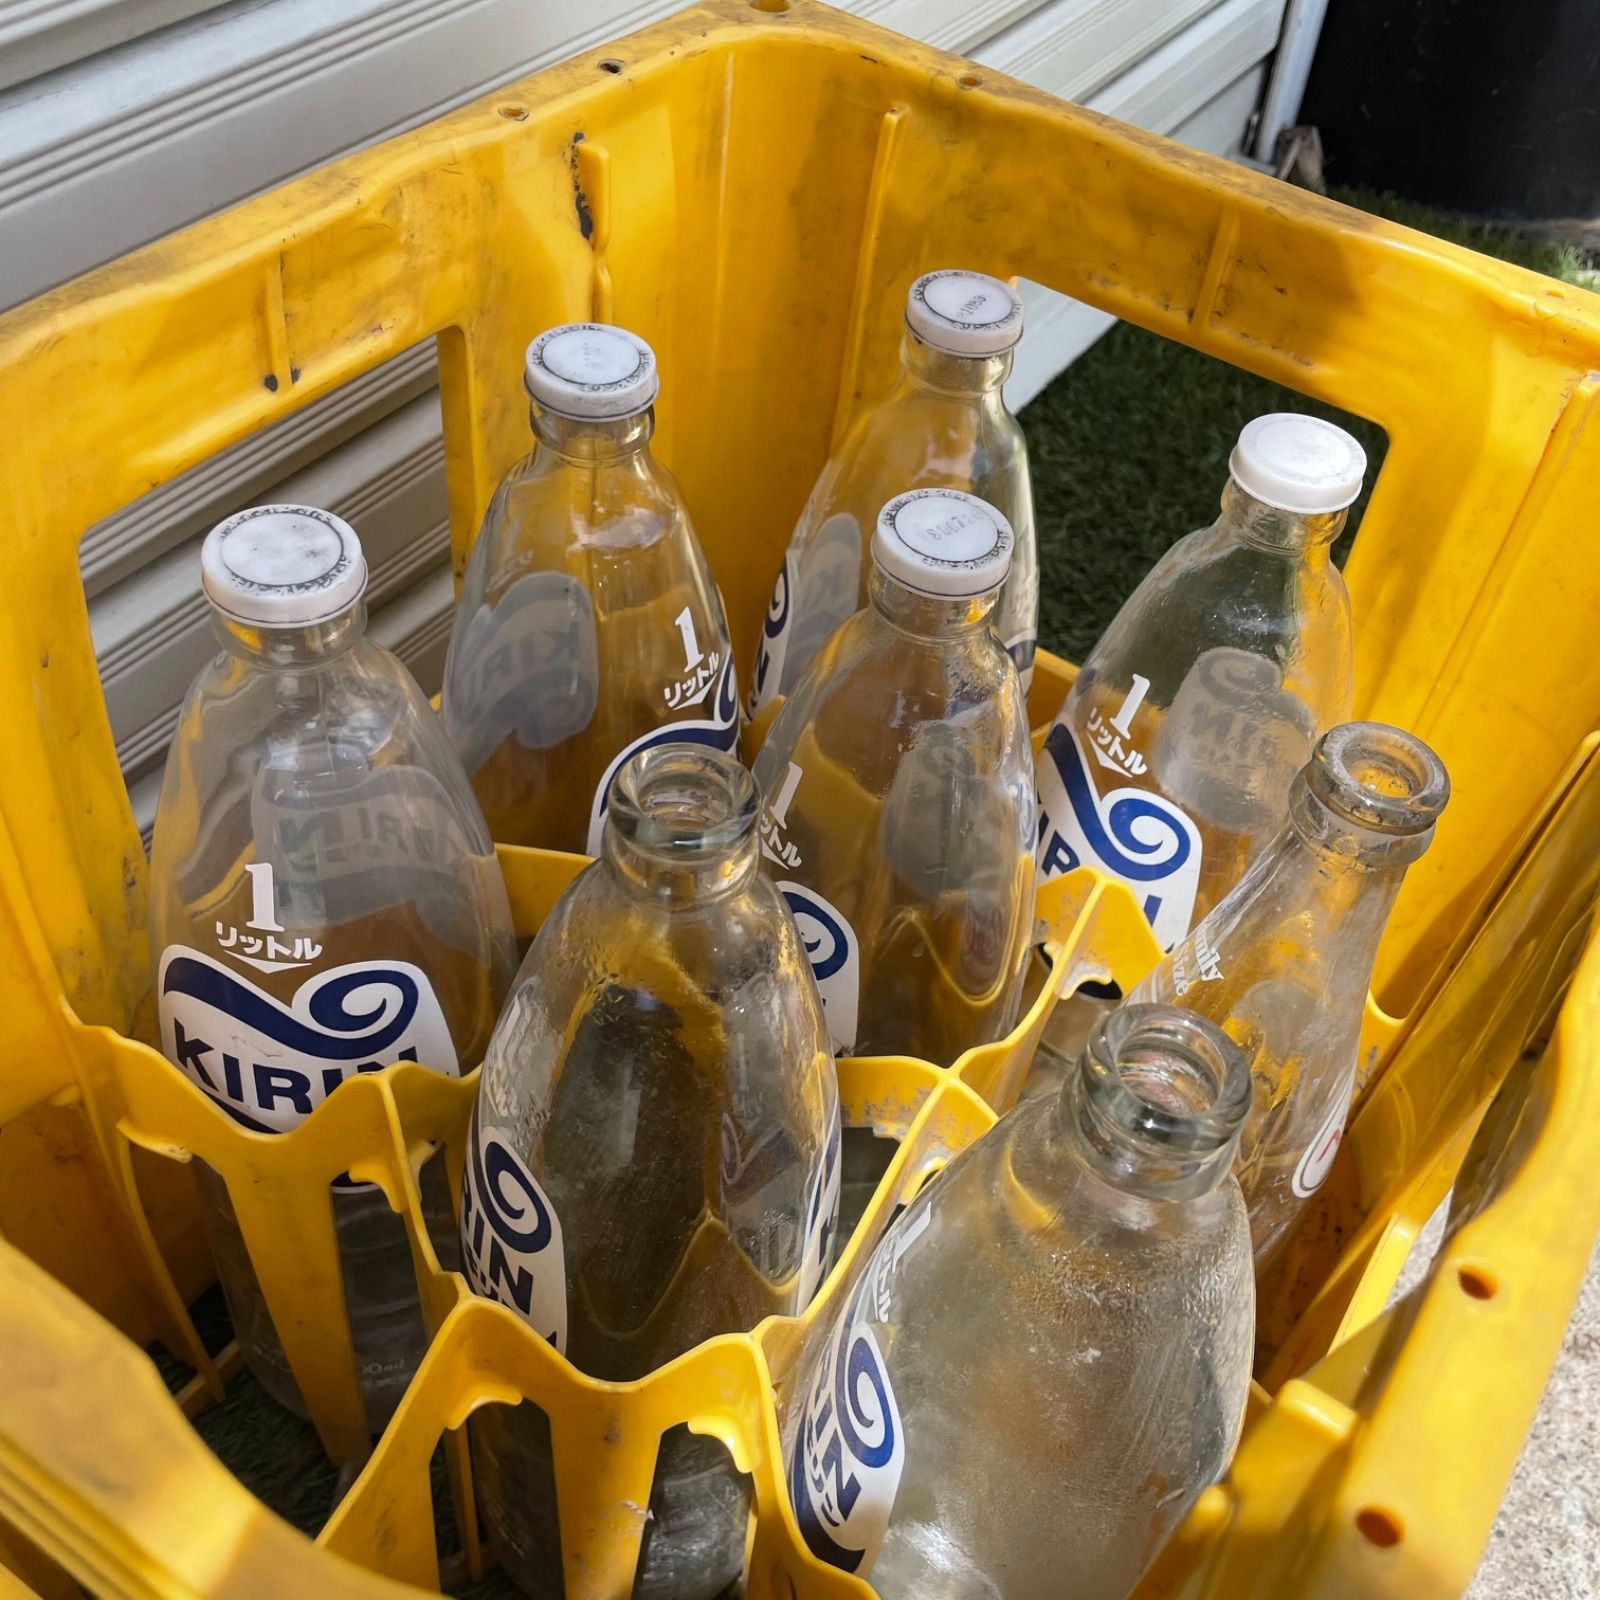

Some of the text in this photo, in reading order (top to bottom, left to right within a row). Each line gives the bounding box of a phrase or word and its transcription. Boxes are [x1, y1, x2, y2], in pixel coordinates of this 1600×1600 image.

[675, 606, 704, 673] 1
[664, 651, 719, 708] リットル
[1109, 673, 1151, 740] 1
[1087, 706, 1148, 776] リットル
[769, 761, 803, 830] 1
[244, 862, 285, 932] 1
[215, 921, 324, 960] リットル
